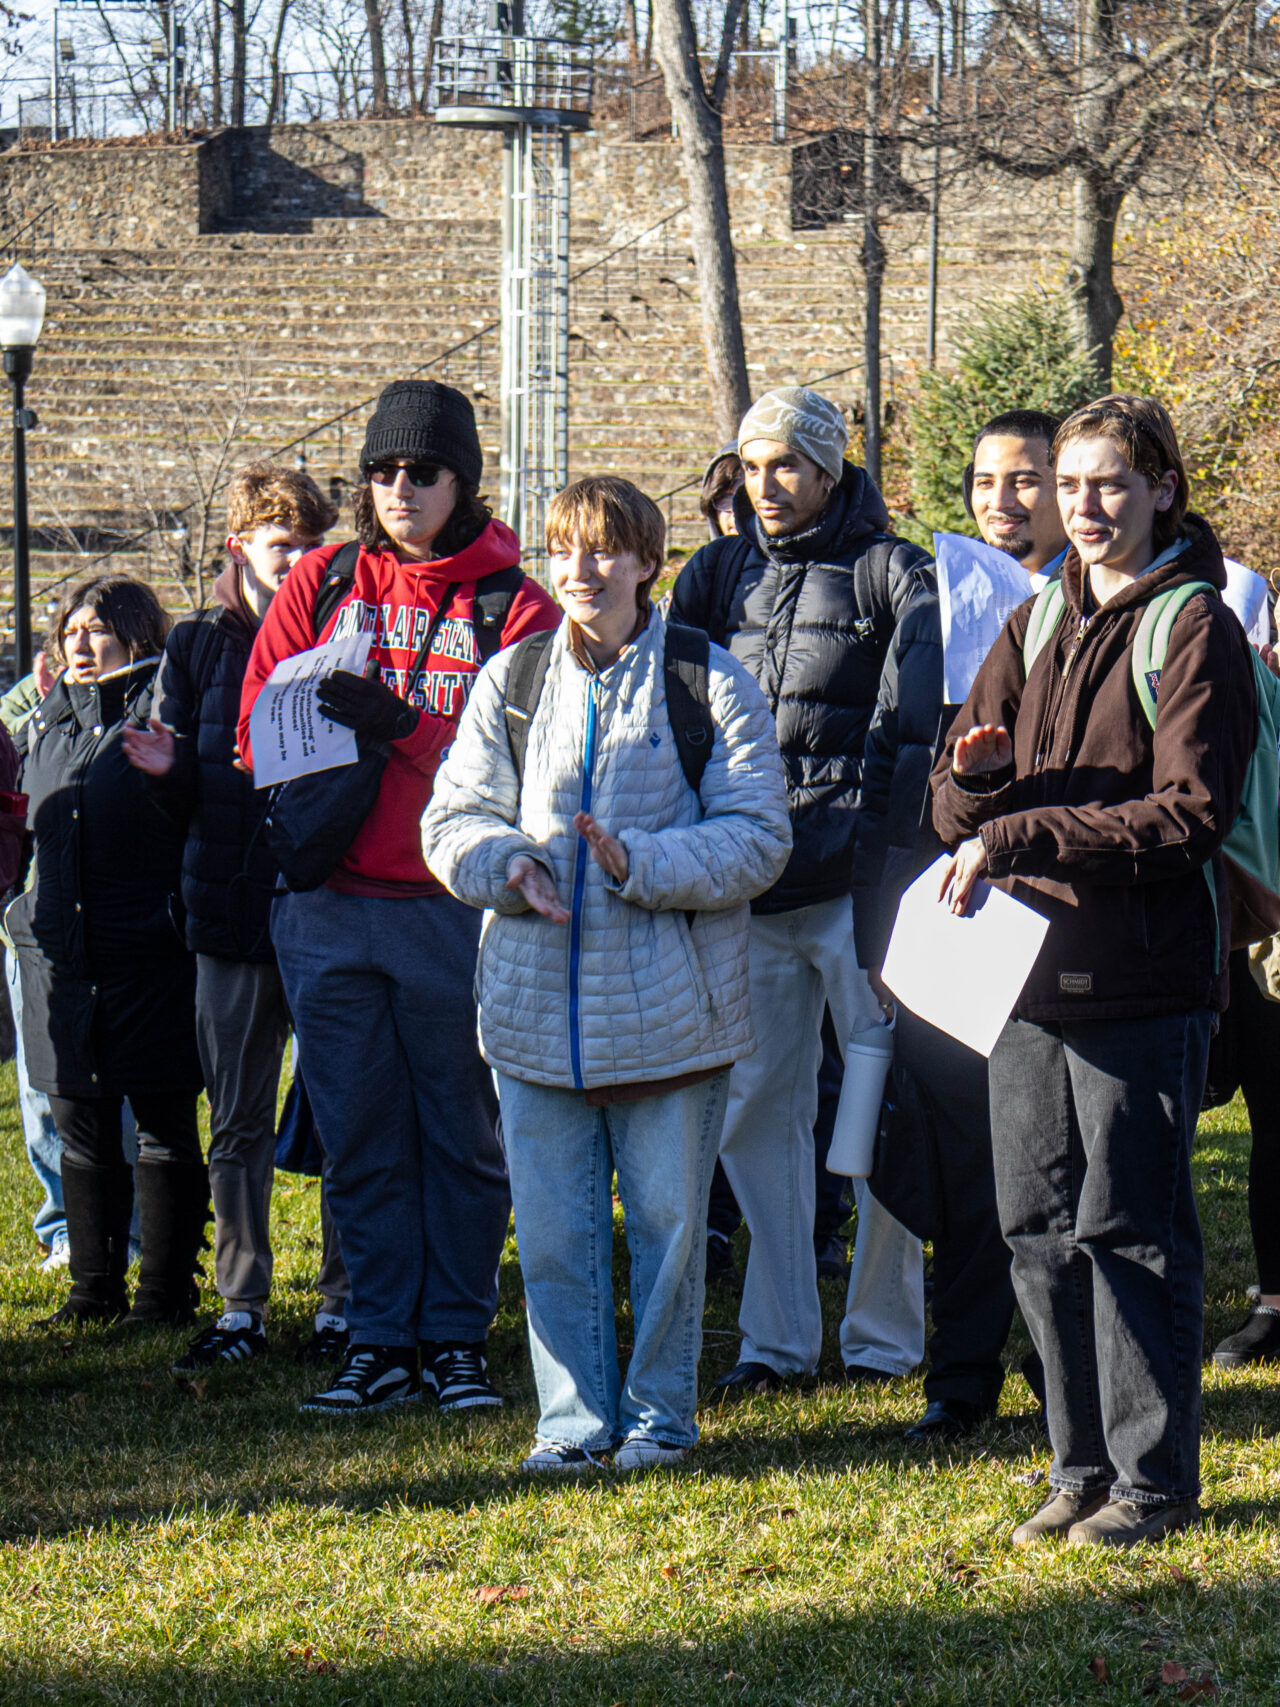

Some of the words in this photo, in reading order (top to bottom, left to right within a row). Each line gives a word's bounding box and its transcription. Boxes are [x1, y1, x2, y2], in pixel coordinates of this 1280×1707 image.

[291, 694, 300, 731] Sciences!
[299, 695, 307, 740] Humanities
[302, 741, 310, 757] and
